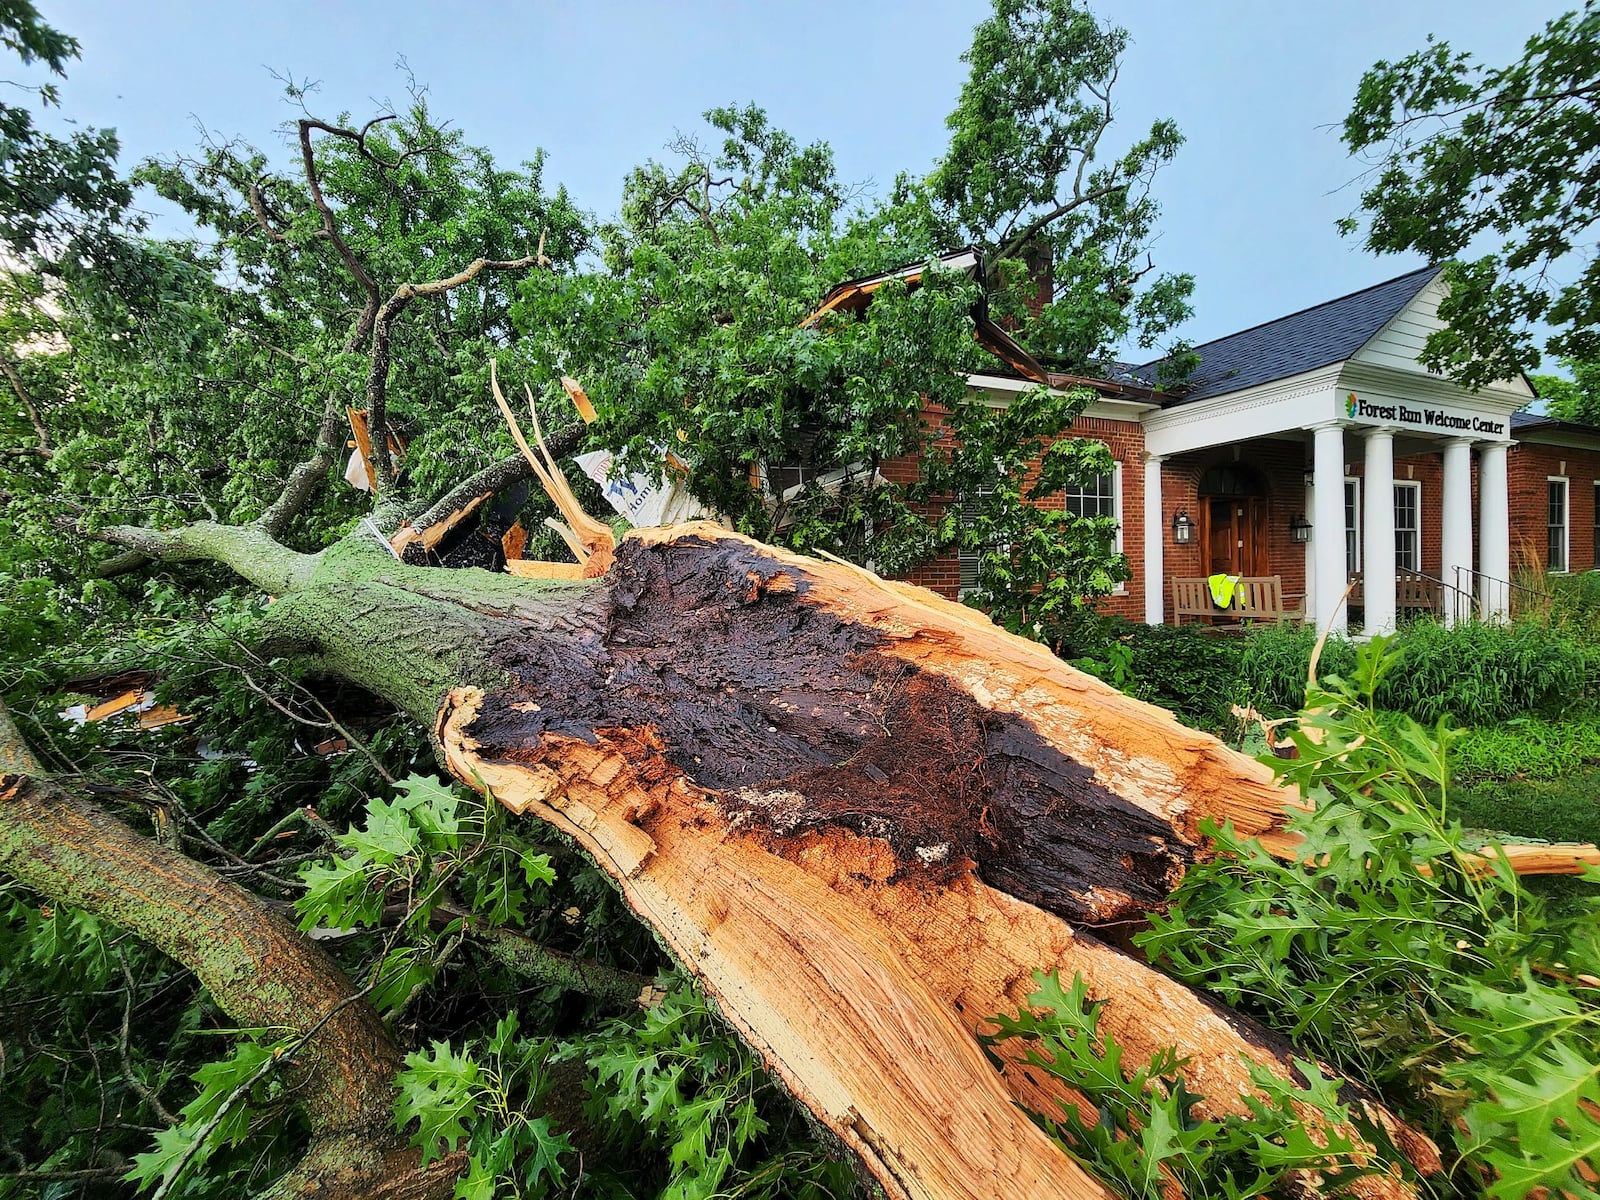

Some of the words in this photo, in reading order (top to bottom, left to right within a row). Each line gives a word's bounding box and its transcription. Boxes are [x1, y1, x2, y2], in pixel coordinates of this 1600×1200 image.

[1358, 399, 1397, 420] Forest
[1399, 406, 1422, 423] Run
[1424, 409, 1471, 430] Welcome
[1473, 417, 1504, 434] Center
